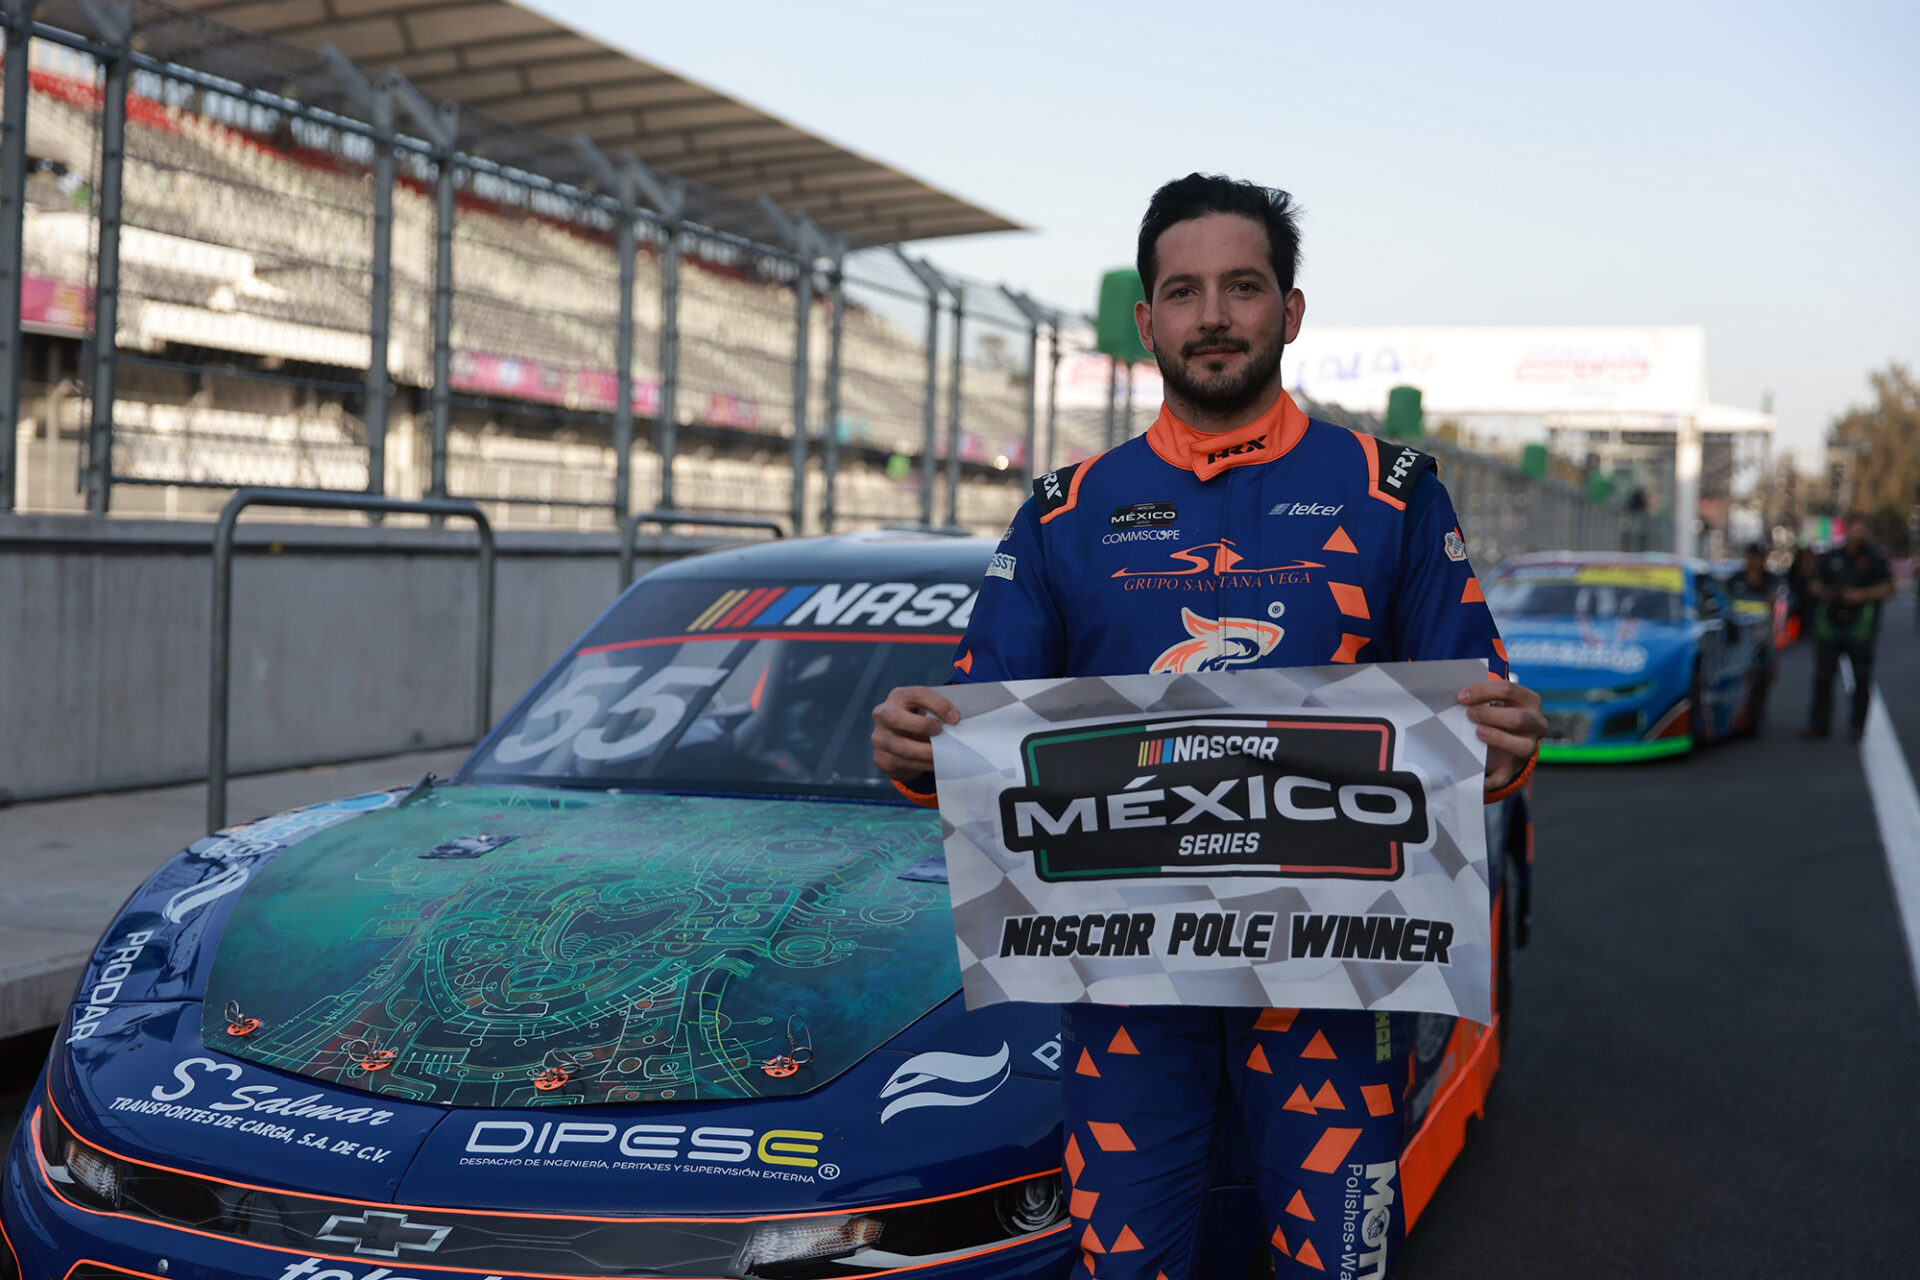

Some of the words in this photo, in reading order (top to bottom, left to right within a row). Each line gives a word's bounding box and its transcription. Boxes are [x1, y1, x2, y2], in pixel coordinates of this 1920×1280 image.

[1207, 435, 1266, 464] HRX
[1386, 447, 1420, 488] HRX
[1041, 471, 1063, 500] RX
[1111, 511, 1176, 524] MÉXICO
[1288, 502, 1344, 516] telcel
[1102, 530, 1180, 545] COMMSCOPE
[1124, 577, 1179, 592] GRUPO
[1183, 574, 1262, 592] SANTANA
[1268, 571, 1311, 586] VEGA
[494, 665, 729, 764] 55
[1172, 735, 1280, 762] NASCAR
[1014, 774, 1413, 838] MÉXICO
[1178, 832, 1261, 857] SERIES
[1000, 912, 1156, 959] NASCAR
[1167, 912, 1274, 958] POLE
[1290, 914, 1454, 965] WINNER
[65, 929, 154, 1044] PRODAR
[209, 1085, 395, 1126] Salmar
[108, 1097, 220, 1124] TRANSPORTES
[213, 1113, 240, 1129] DE
[239, 1120, 294, 1144] CARGA,
[297, 1132, 328, 1149] S.A.
[329, 1139, 359, 1155] DE
[356, 1147, 392, 1163] C.V.
[465, 1120, 824, 1168] DIPESE
[459, 1157, 522, 1167] DESPACHO
[524, 1158, 540, 1167] DE
[543, 1159, 610, 1170] INGENIERÍA,
[612, 1161, 671, 1172] PERITAJES
[673, 1163, 683, 1172] Y
[682, 1164, 760, 1179] SUPERVISIÓN
[762, 1170, 816, 1184] EXTERNA
